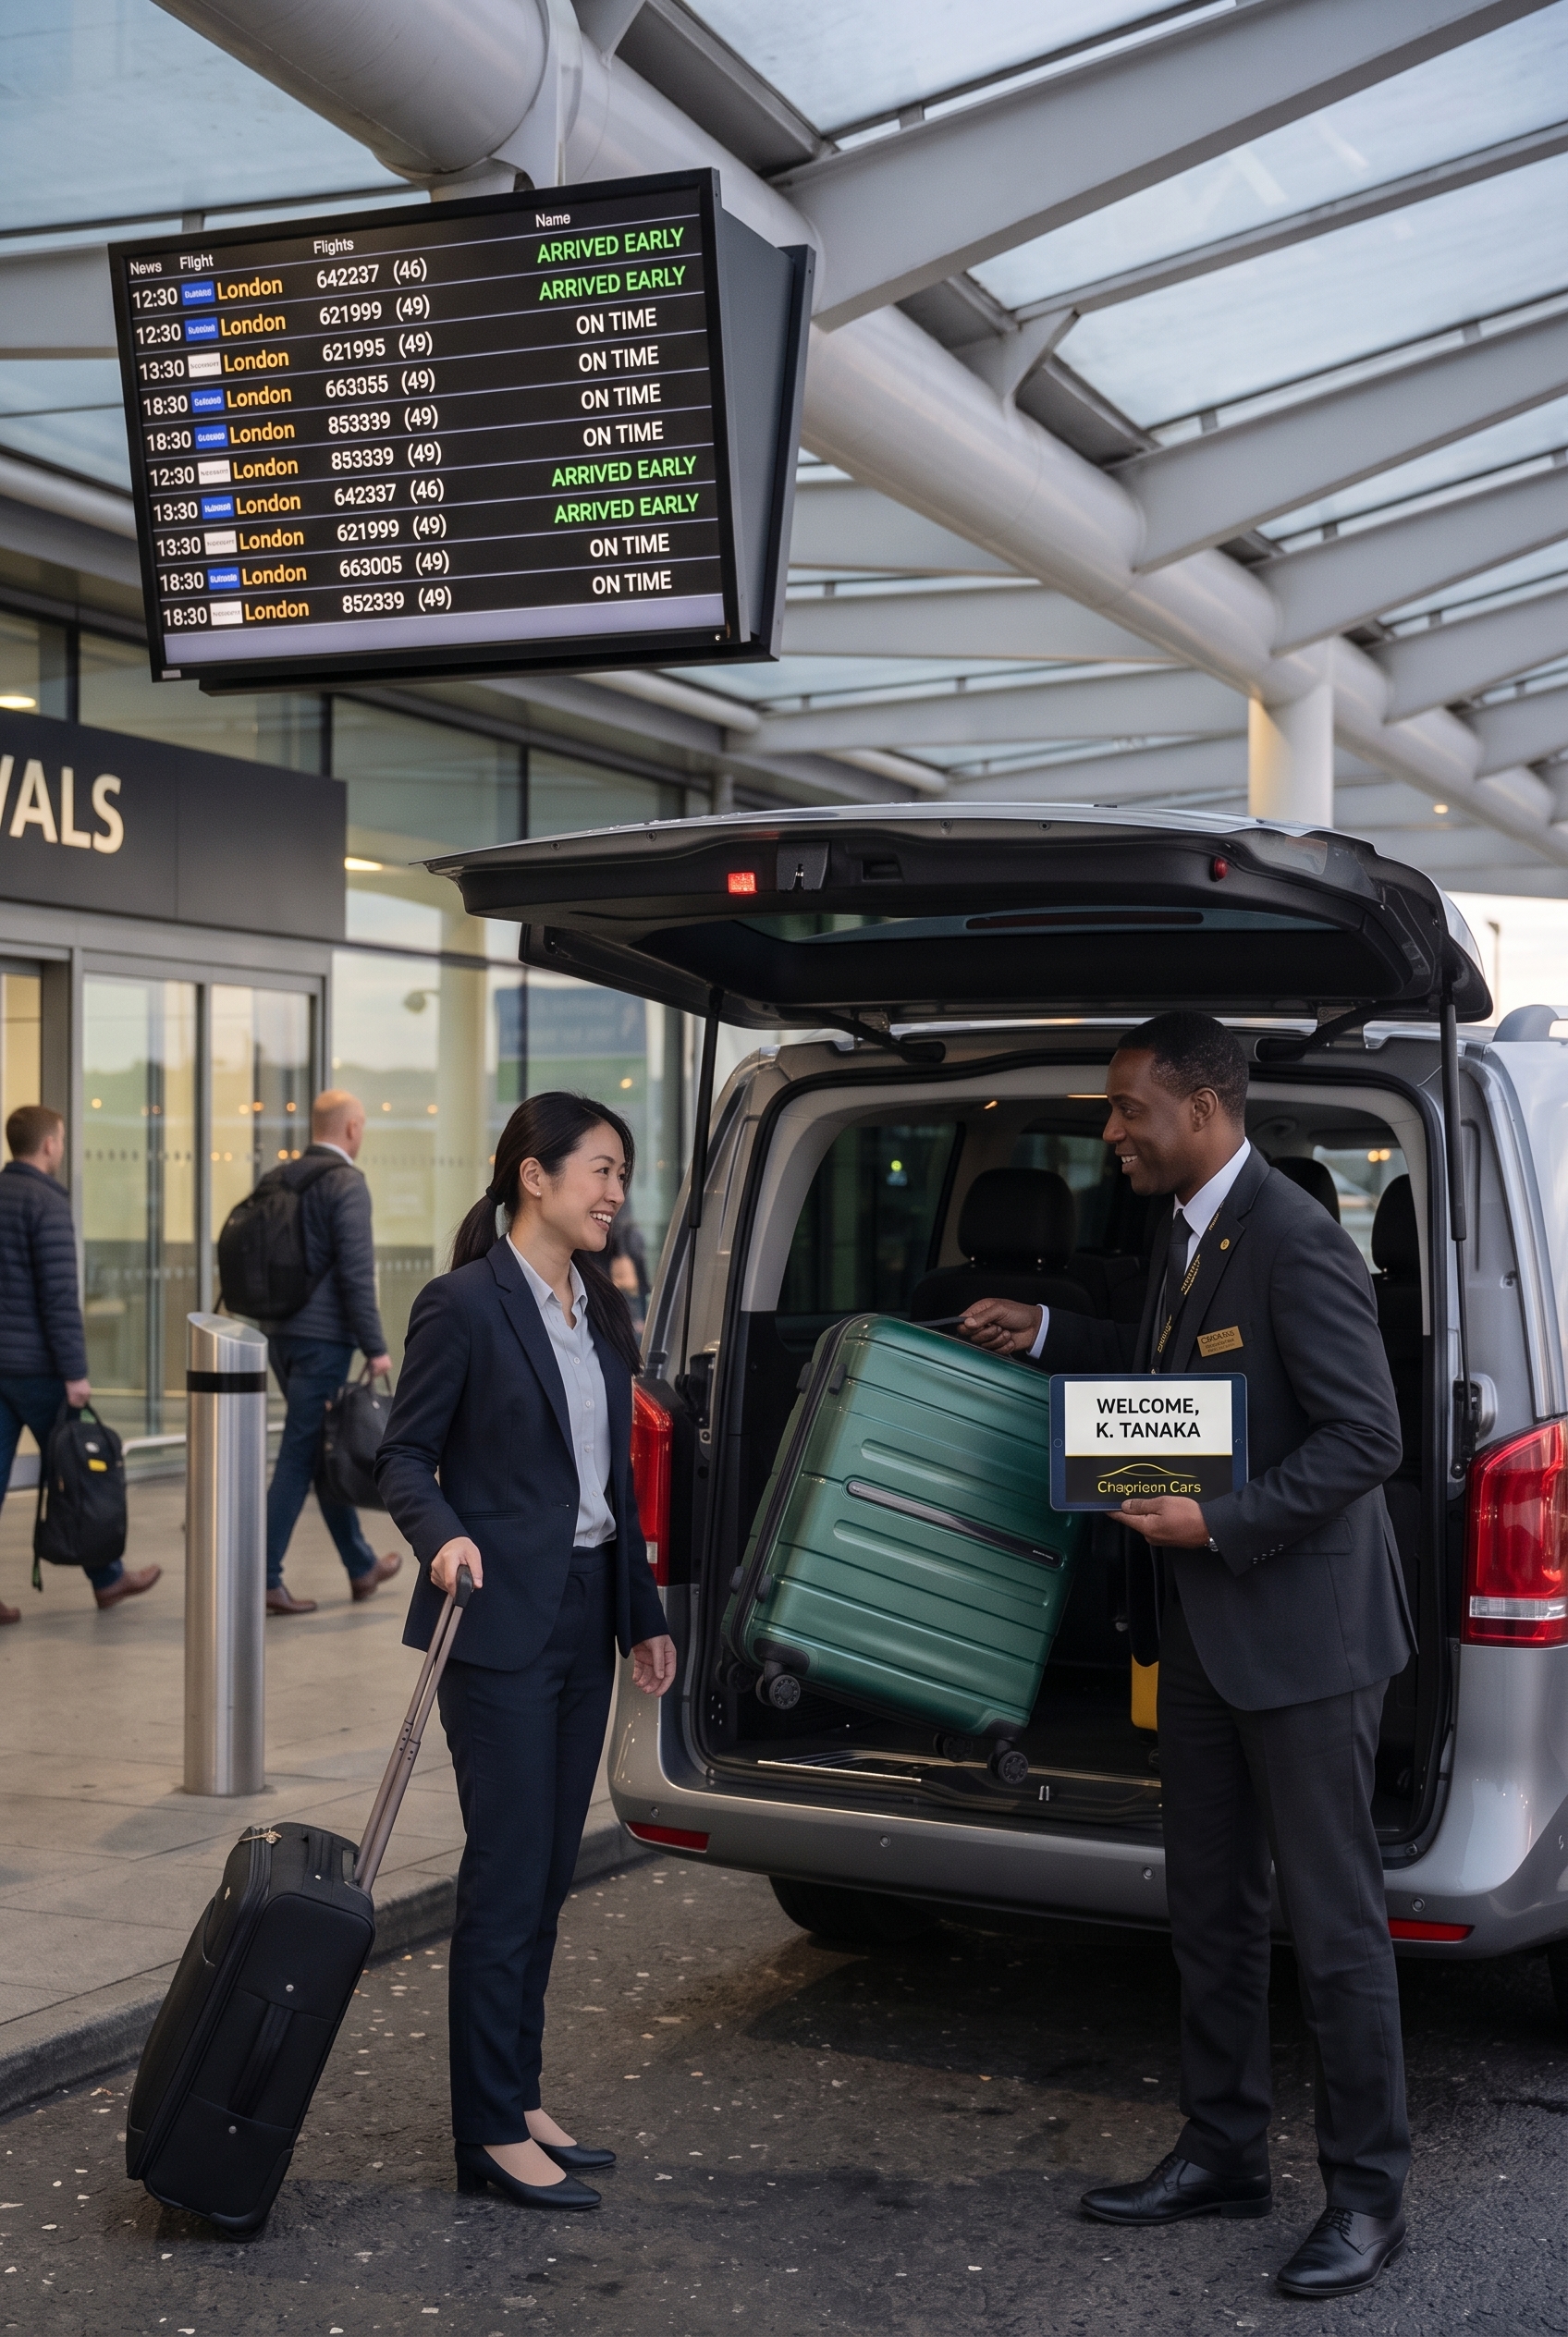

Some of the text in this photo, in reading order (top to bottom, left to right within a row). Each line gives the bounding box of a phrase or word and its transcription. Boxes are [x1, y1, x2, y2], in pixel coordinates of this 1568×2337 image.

[130, 214, 570, 275] News Flight Flights Name
[133, 288, 178, 308] 12:30
[217, 277, 282, 300] London
[317, 264, 379, 288] 642237
[394, 258, 427, 285] (46)
[537, 236, 619, 263] ARRIVED
[625, 227, 683, 252] EARLY
[137, 324, 181, 344] 12:30
[221, 313, 286, 336] London
[320, 301, 382, 324] 621999
[397, 294, 430, 322] (49)
[539, 275, 620, 300] ARRIVED
[626, 266, 685, 290] EARLY
[141, 308, 656, 380] 13:30 London 621995 (49) ON TIME
[143, 396, 188, 415] 18:30
[227, 385, 291, 408] London
[401, 368, 435, 395] (49)
[579, 351, 606, 372] ON
[611, 346, 659, 368] TIME
[147, 431, 191, 451] 18:30
[230, 422, 295, 444] London
[328, 411, 390, 434] 853339
[405, 405, 438, 431] (49)
[582, 389, 608, 409] ON
[613, 384, 661, 406] TIME
[151, 422, 664, 486] 12:30 London 853339 (49) ON TIME
[154, 502, 198, 521] 13:30
[237, 494, 300, 514] London
[335, 483, 396, 506] 642337
[410, 478, 444, 504] (46)
[552, 462, 631, 486] ARRIVED
[638, 456, 696, 479] EARLY
[157, 494, 699, 557] 13:30 London 621999 (49) ARRIVED EARLY
[160, 572, 203, 591] 18:30
[242, 564, 306, 585] London
[340, 556, 402, 577] 663005
[416, 550, 449, 576] (49)
[590, 538, 618, 557] ON
[622, 533, 669, 555] TIME
[164, 570, 672, 626] 18:30 London 852339 (49) ON TIME
[1096, 1398, 1199, 1416] WELCOME,
[1096, 1422, 1201, 1438] K. TANAKA
[1170, 1480, 1202, 1493] Cars
